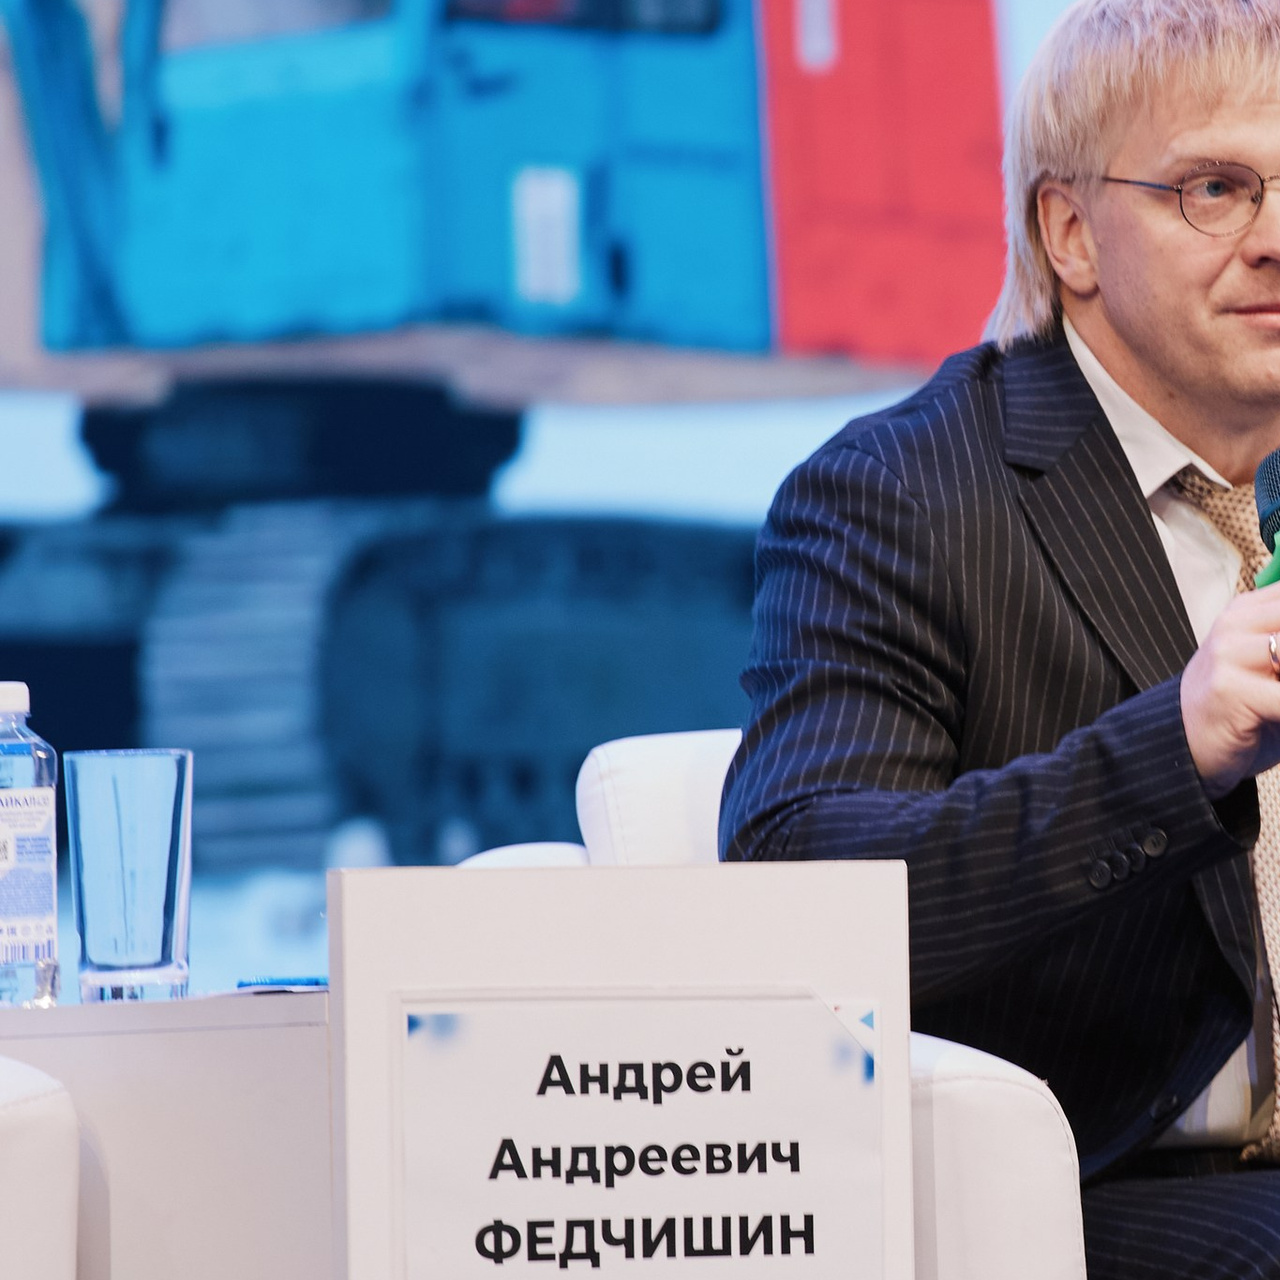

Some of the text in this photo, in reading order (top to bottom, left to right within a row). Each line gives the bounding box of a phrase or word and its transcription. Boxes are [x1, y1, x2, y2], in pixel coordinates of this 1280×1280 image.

[536, 1047, 752, 1105] Андрей
[488, 1138, 801, 1189] Андреевич
[474, 1213, 816, 1270] ФЕДЧИШИН
